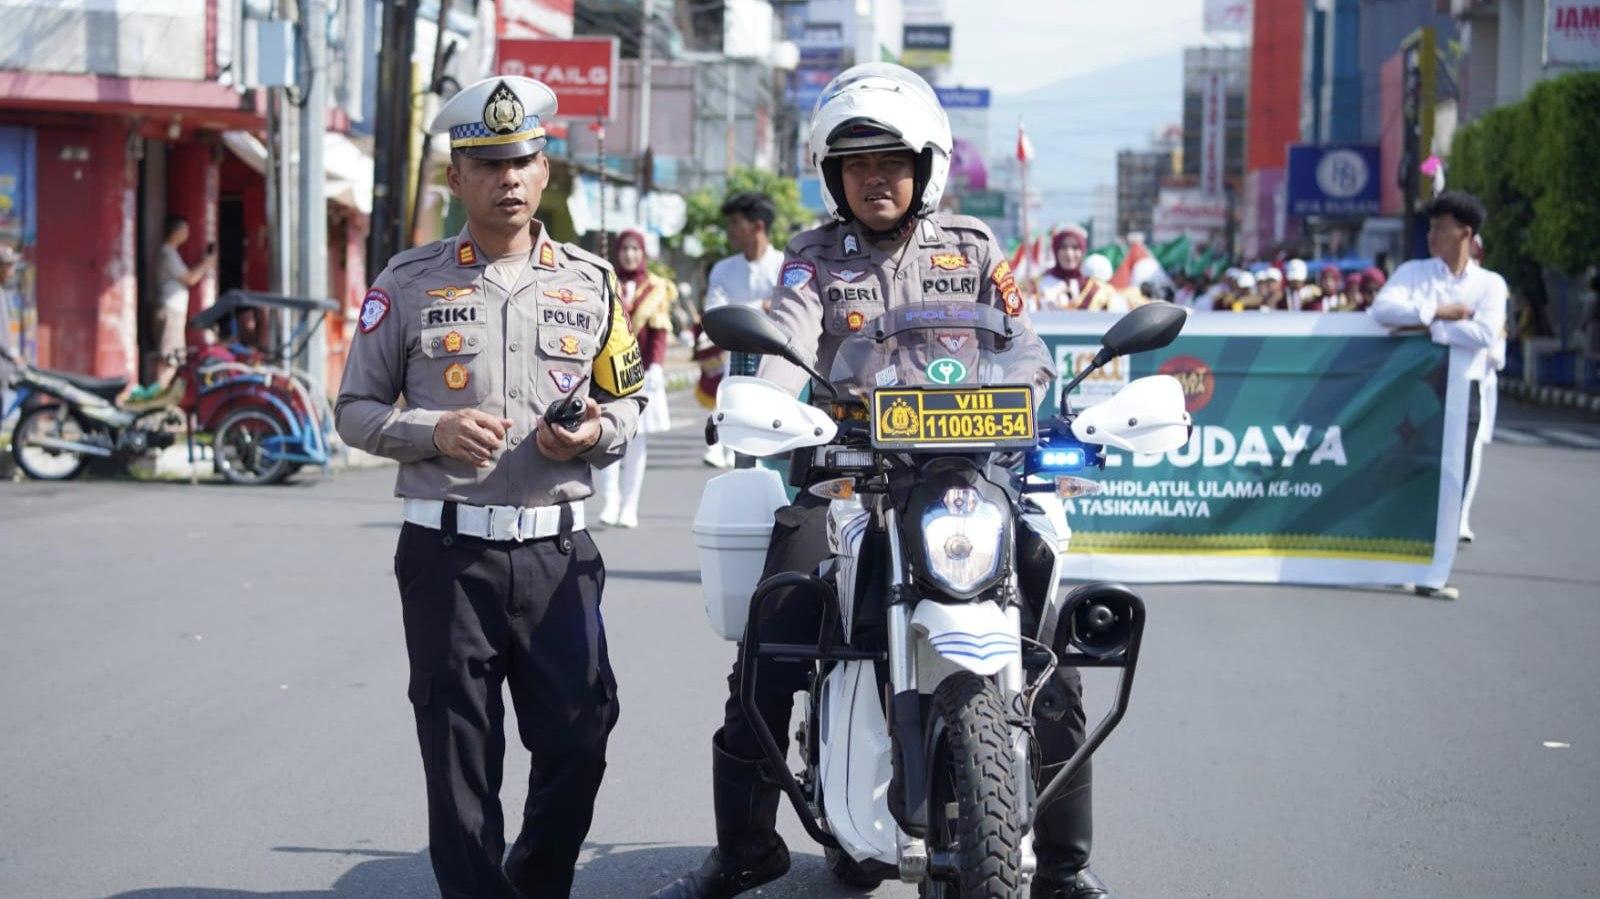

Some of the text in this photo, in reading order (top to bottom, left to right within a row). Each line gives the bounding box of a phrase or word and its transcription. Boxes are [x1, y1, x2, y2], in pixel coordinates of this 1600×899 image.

[828, 286, 878, 302] DERI
[922, 276, 977, 294] POLRI
[428, 306, 477, 325] RIKI
[543, 308, 591, 330] POLRI
[955, 393, 994, 409] VIII
[926, 414, 1026, 437] 110036-54
[1094, 480, 1322, 498] AHDLATUL ULAMA KE-100
[1079, 499, 1210, 518] TASIKMALAYA
